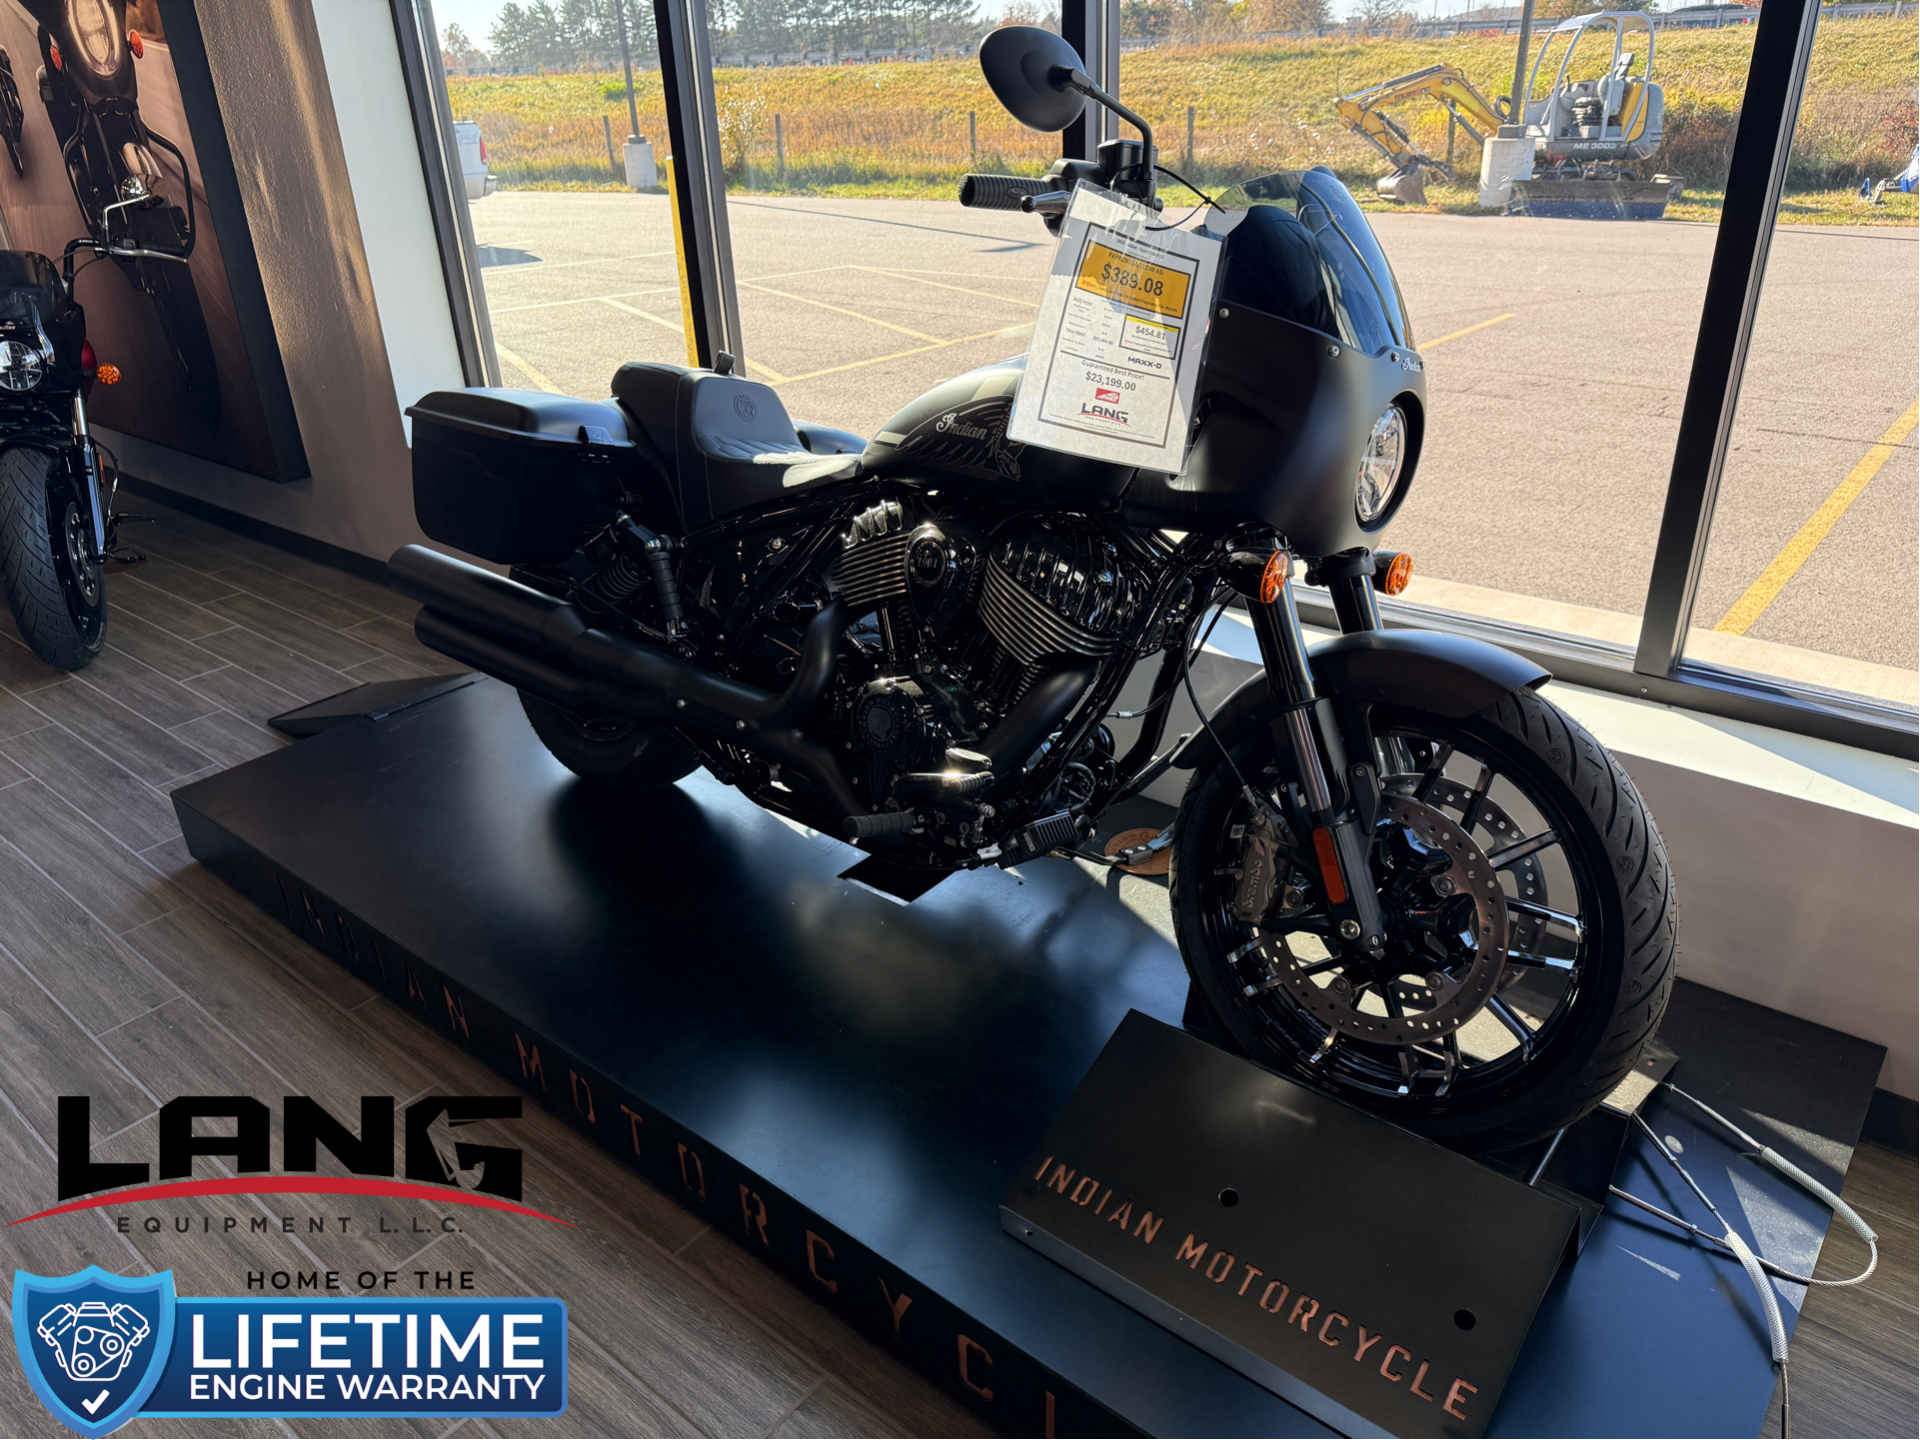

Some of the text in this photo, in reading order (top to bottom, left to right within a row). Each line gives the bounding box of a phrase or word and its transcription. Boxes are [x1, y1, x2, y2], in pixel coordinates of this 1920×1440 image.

[1101, 262, 1164, 296] $389.08
[1155, 267, 1165, 276] AS:
[1135, 325, 1166, 340] $454.81
[1081, 360, 1145, 381] Guaranteed Best Price!
[1085, 371, 1137, 391] $23,199.00
[1081, 402, 1129, 423] LANG
[936, 412, 988, 440] Indian
[917, 558, 938, 568] 1901
[1242, 860, 1263, 908] brembo
[276, 874, 470, 1039] INDIAN
[1034, 1155, 1479, 1421] INDIAN MOTORCYCLE
